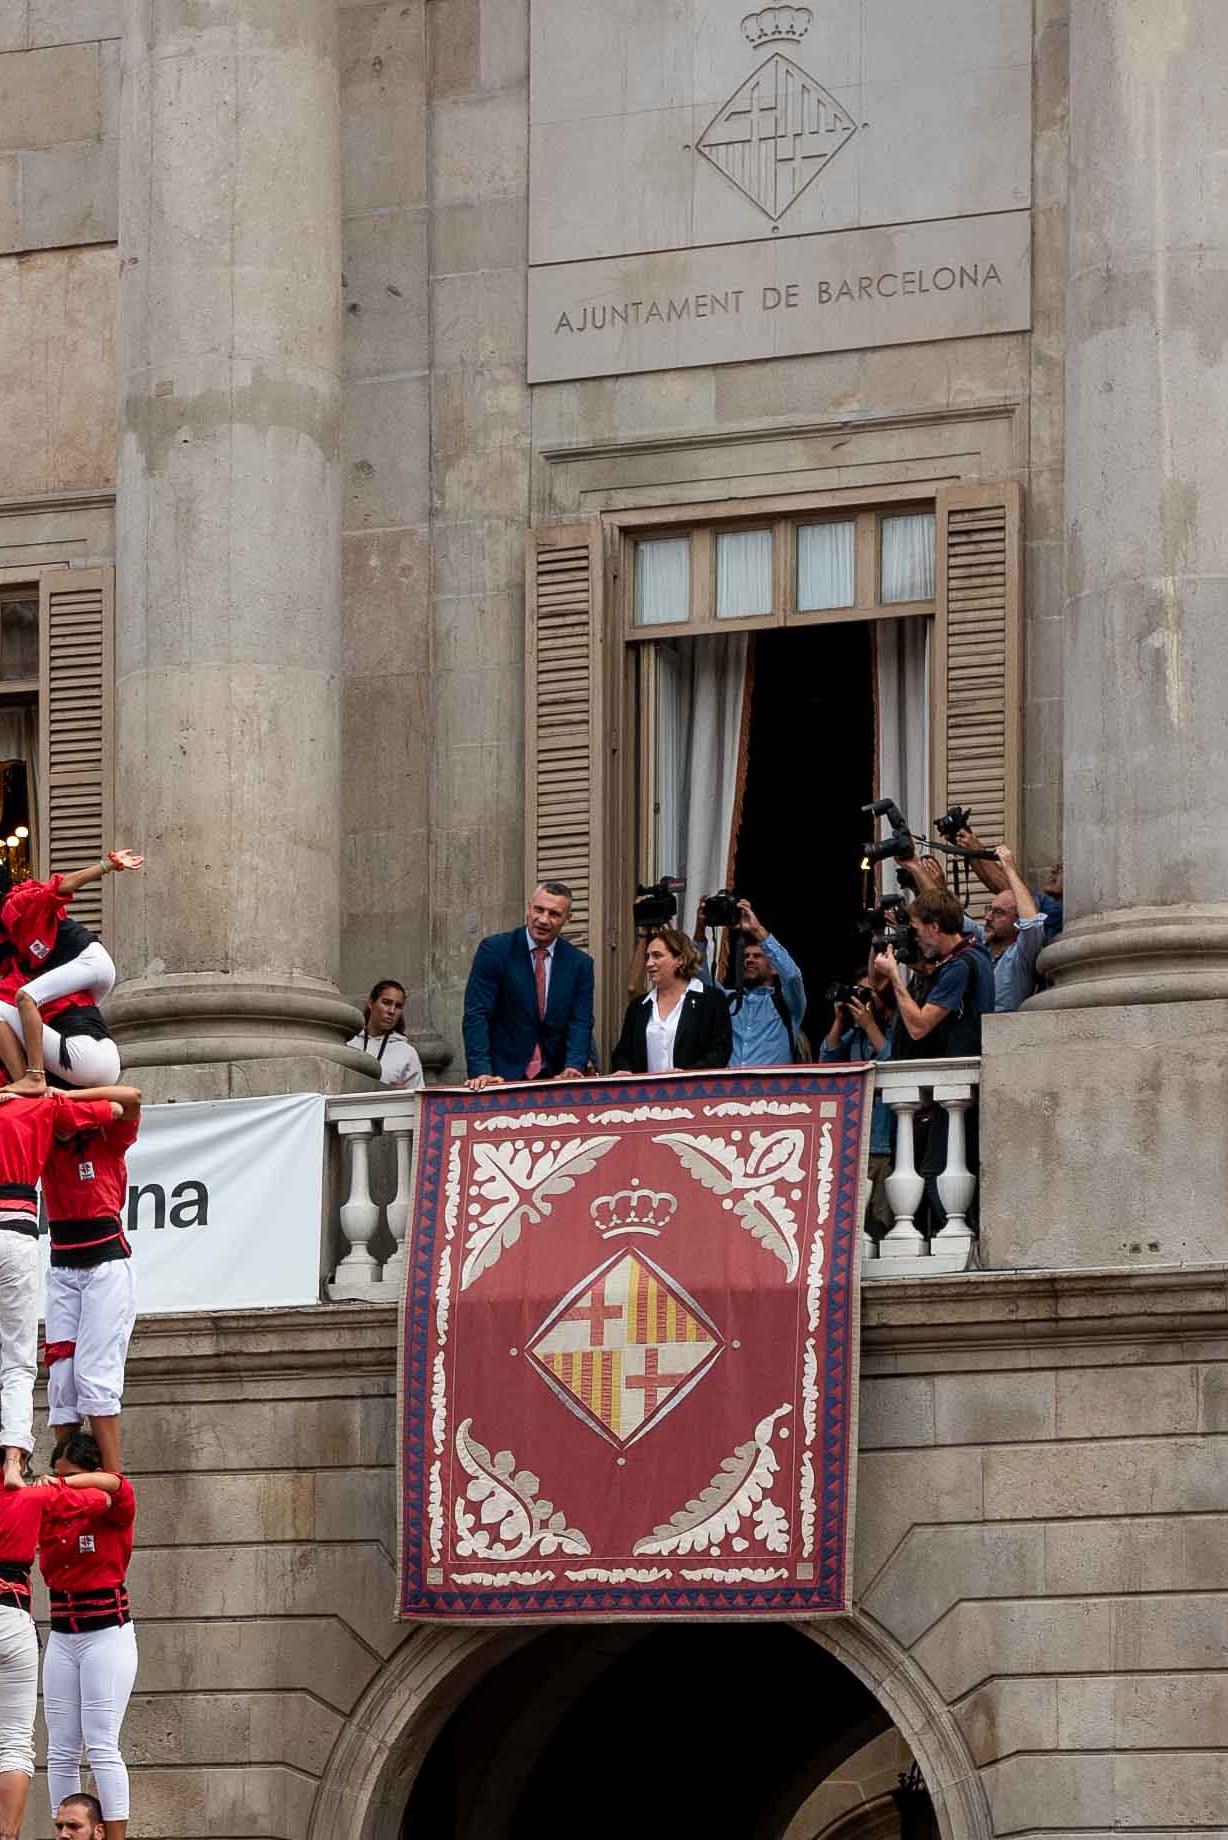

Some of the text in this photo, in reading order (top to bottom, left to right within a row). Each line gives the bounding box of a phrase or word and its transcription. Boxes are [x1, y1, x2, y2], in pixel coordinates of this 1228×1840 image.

[554, 262, 1002, 335] AJUNTAMENT DE BARCELONA
